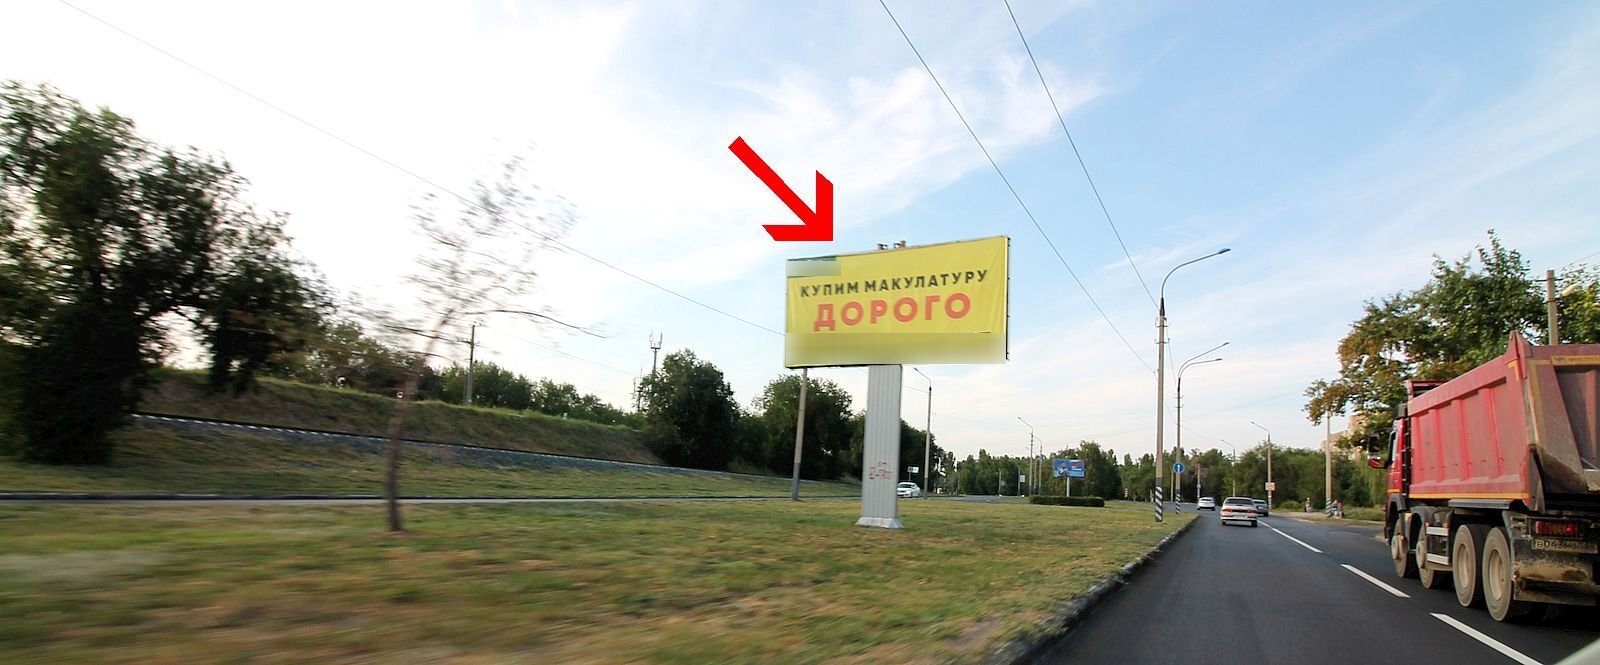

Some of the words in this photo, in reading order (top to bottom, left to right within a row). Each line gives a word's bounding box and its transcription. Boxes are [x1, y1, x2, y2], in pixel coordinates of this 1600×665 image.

[800, 281, 859, 297] КУПИМ
[865, 270, 987, 292] МАКУЛАТУРУ
[814, 293, 971, 331] ДОРОГО
